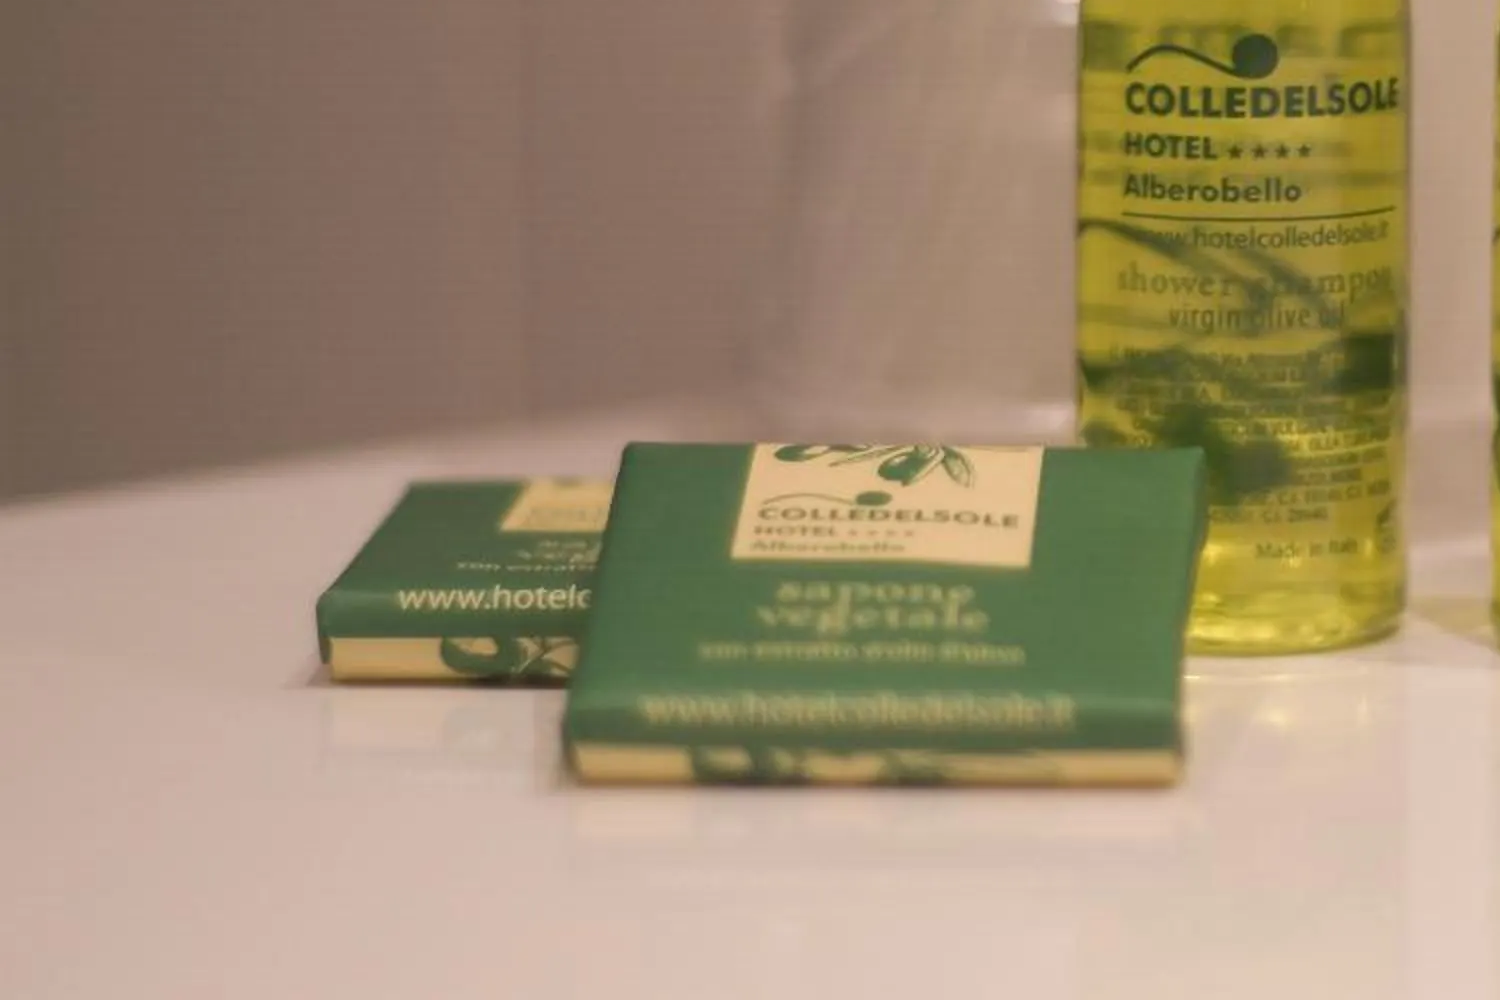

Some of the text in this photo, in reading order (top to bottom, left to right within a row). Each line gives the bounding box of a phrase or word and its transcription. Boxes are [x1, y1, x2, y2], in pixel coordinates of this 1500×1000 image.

[1124, 77, 1399, 118] COLLEDELSOLE
[1124, 132, 1218, 160] HOTEL
[1124, 173, 1302, 203] Alberobello
[1133, 219, 1389, 250] ww.hotelcolledelsole.it
[1118, 260, 1234, 297] shower
[1168, 302, 1241, 336] virgin
[754, 526, 837, 537] HOTEL
[757, 507, 1020, 529] COLLEDELSOLE
[400, 584, 593, 611] www.hotelc
[776, 579, 976, 614] sapone
[756, 603, 991, 636] vegetale
